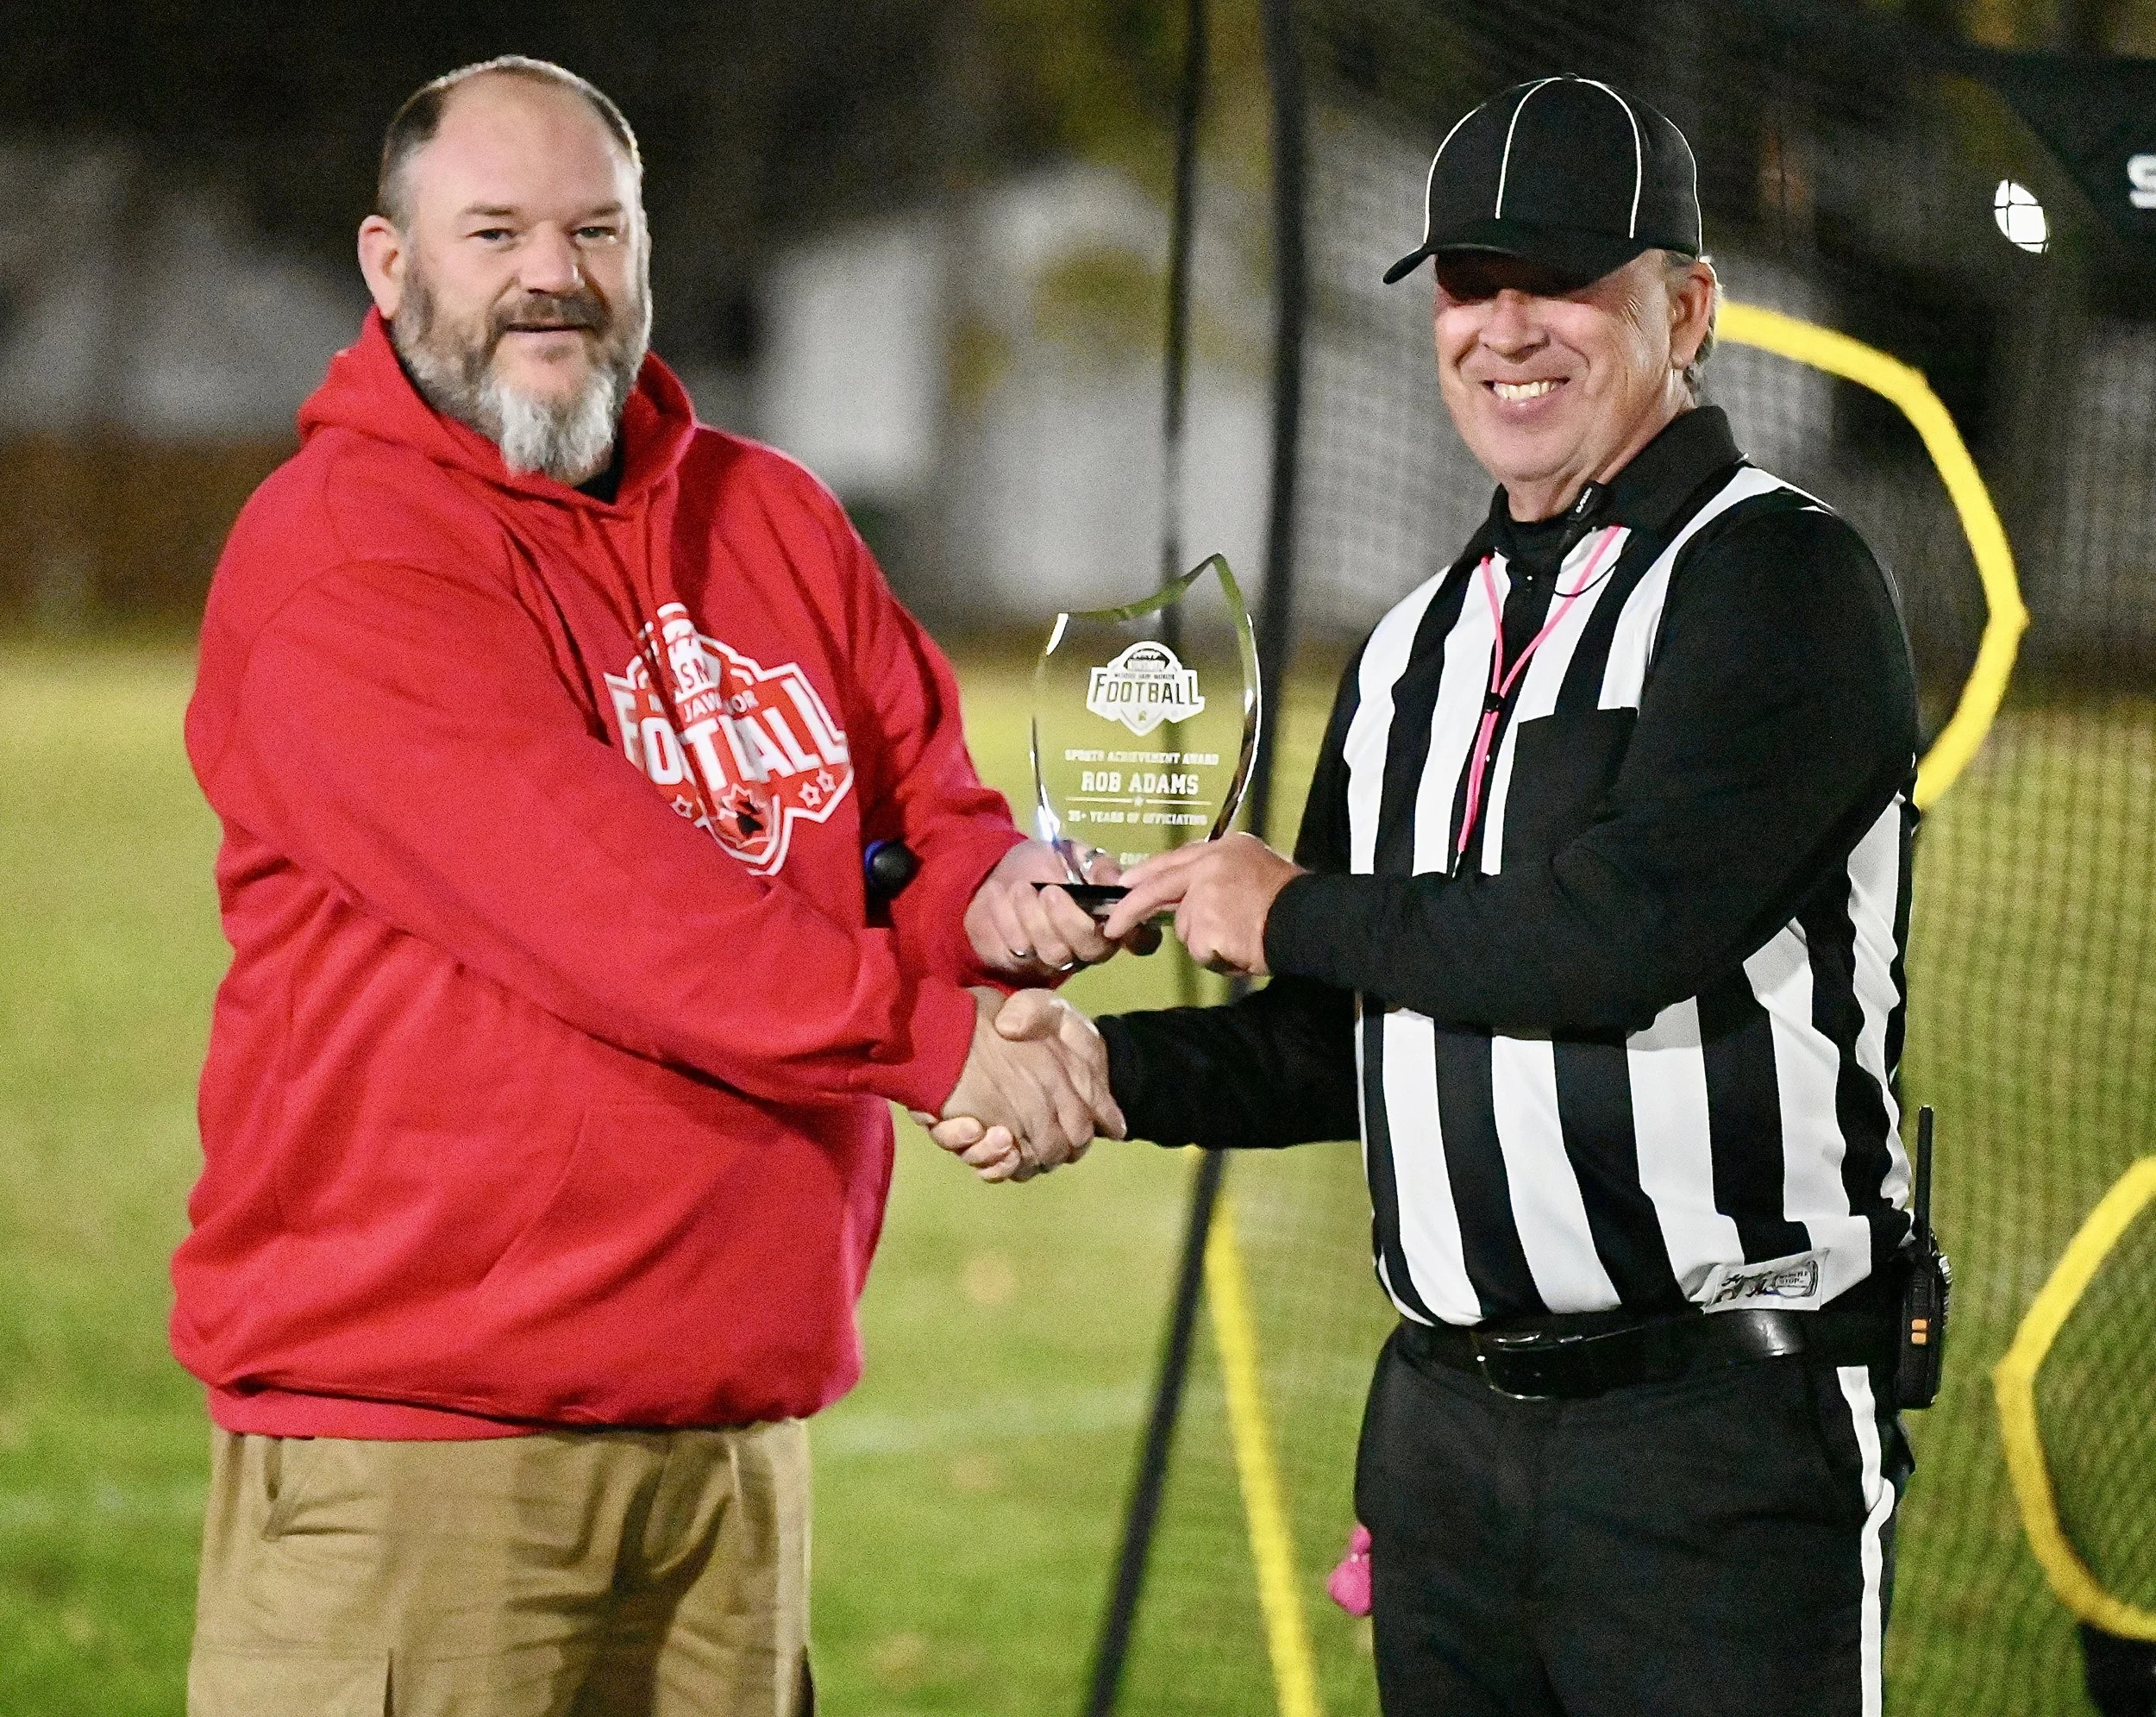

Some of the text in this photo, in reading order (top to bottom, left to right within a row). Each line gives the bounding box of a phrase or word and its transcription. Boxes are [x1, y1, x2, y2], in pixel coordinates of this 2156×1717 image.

[1093, 673, 1199, 705] FOOTBALL
[1107, 750, 1181, 764] ACHIEVEMENT
[1181, 753, 1219, 766] AWARD
[1081, 771, 1199, 795] ROB ADAMS
[1089, 811, 1125, 824] YEARS
[1142, 812, 1207, 825] OFFICIATING
